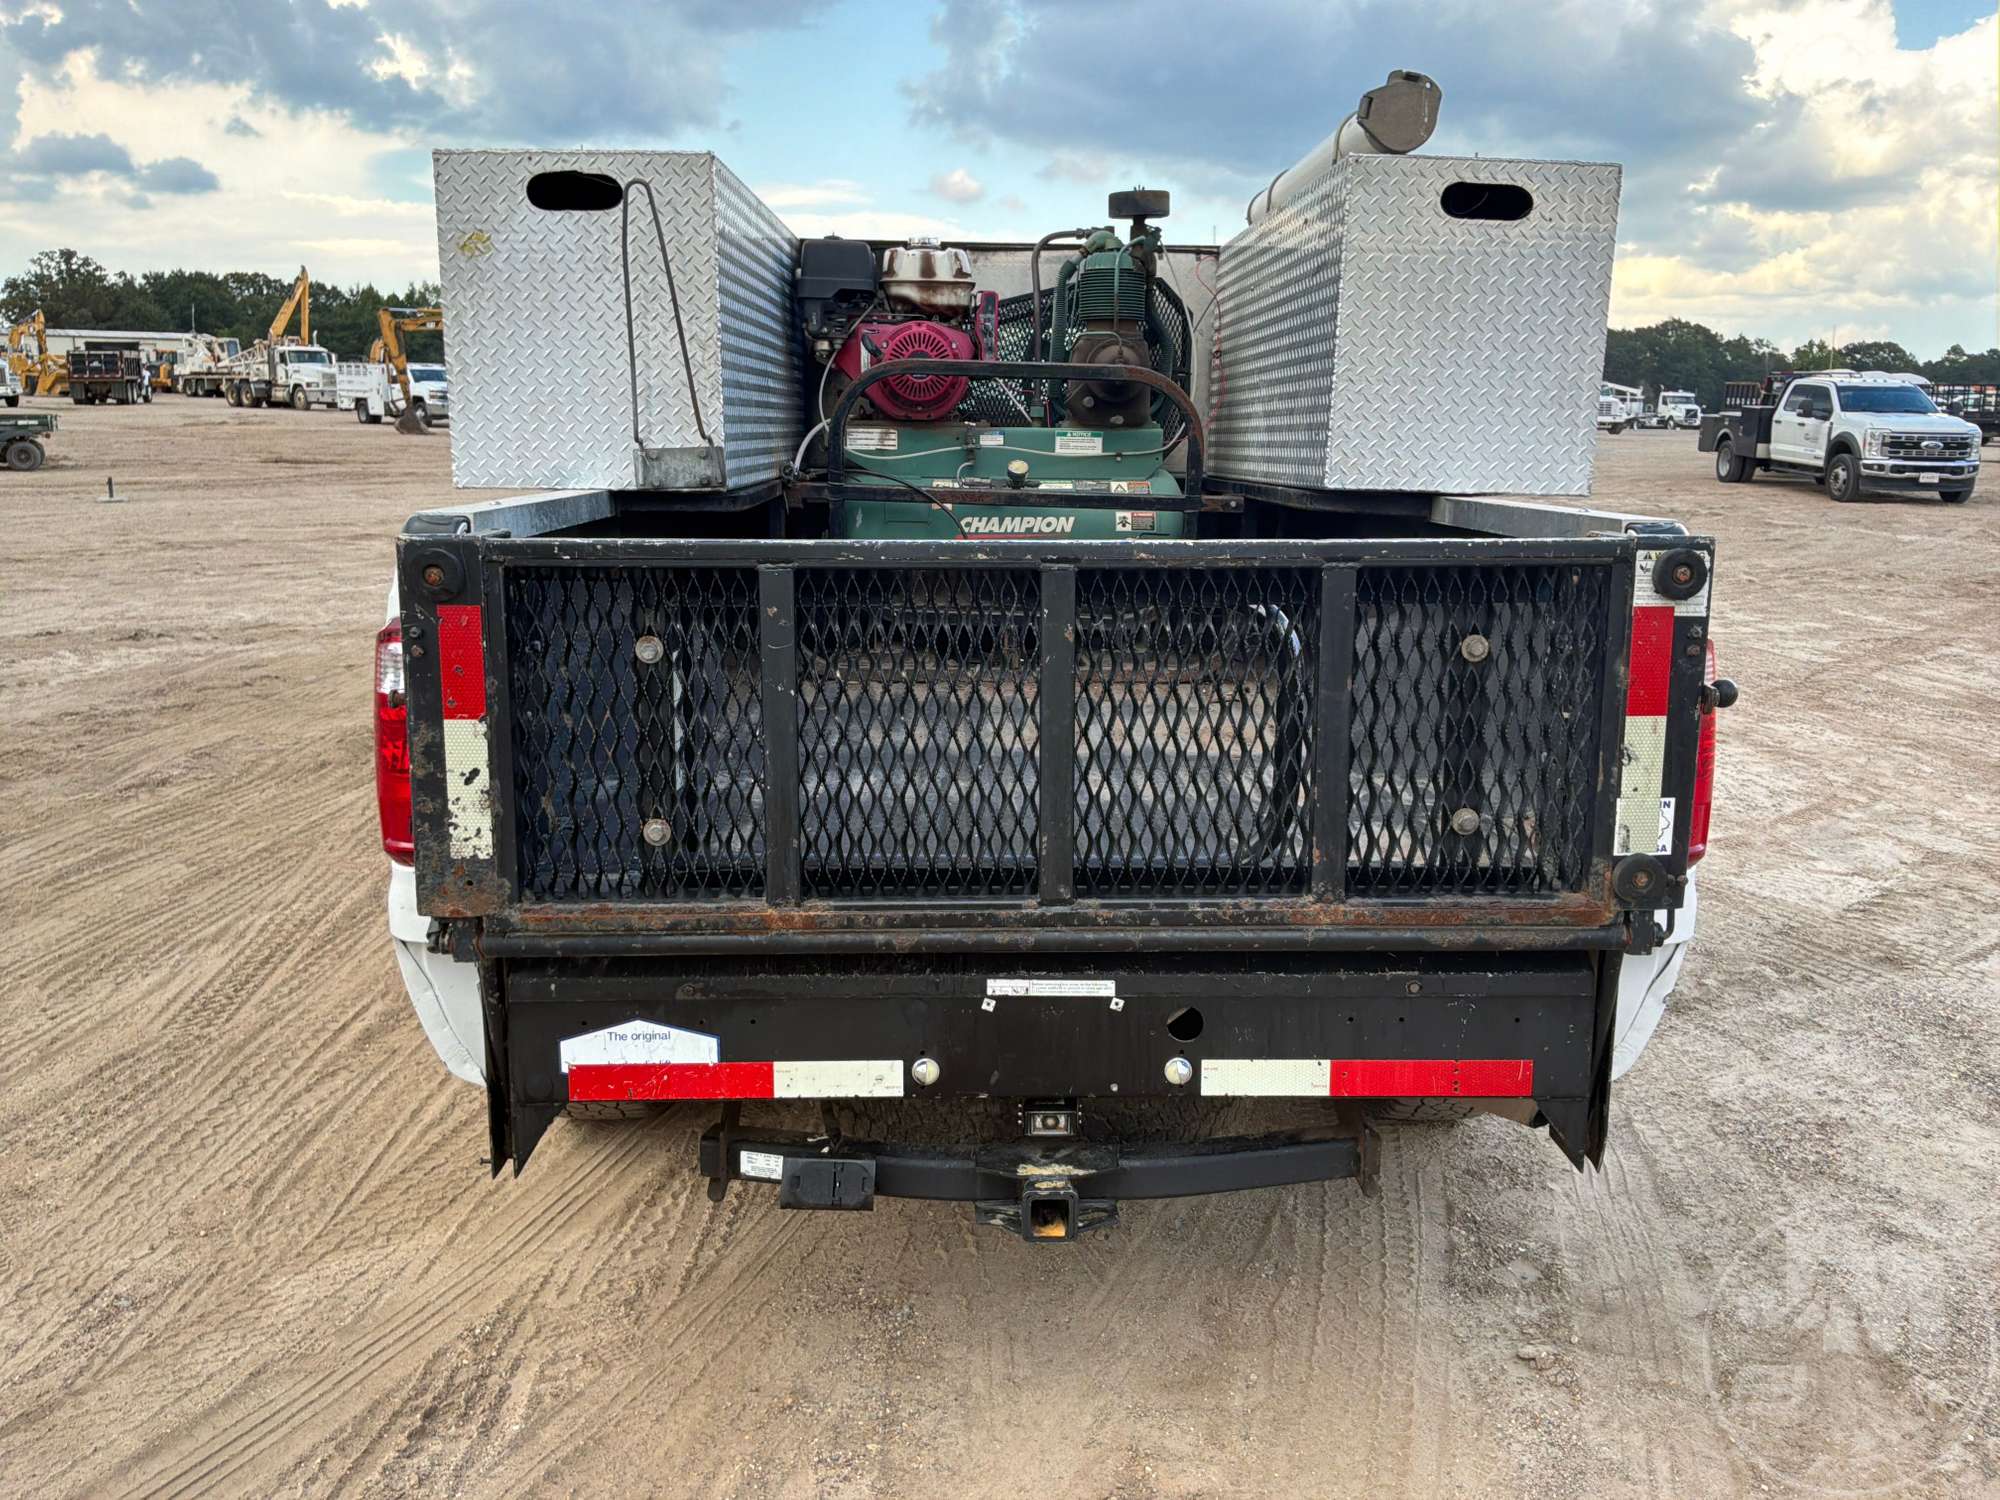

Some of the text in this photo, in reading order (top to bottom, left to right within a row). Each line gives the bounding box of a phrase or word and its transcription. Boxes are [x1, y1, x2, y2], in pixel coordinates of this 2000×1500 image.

[960, 516, 1076, 533] CHAMPION
[607, 1030, 671, 1043] The original
